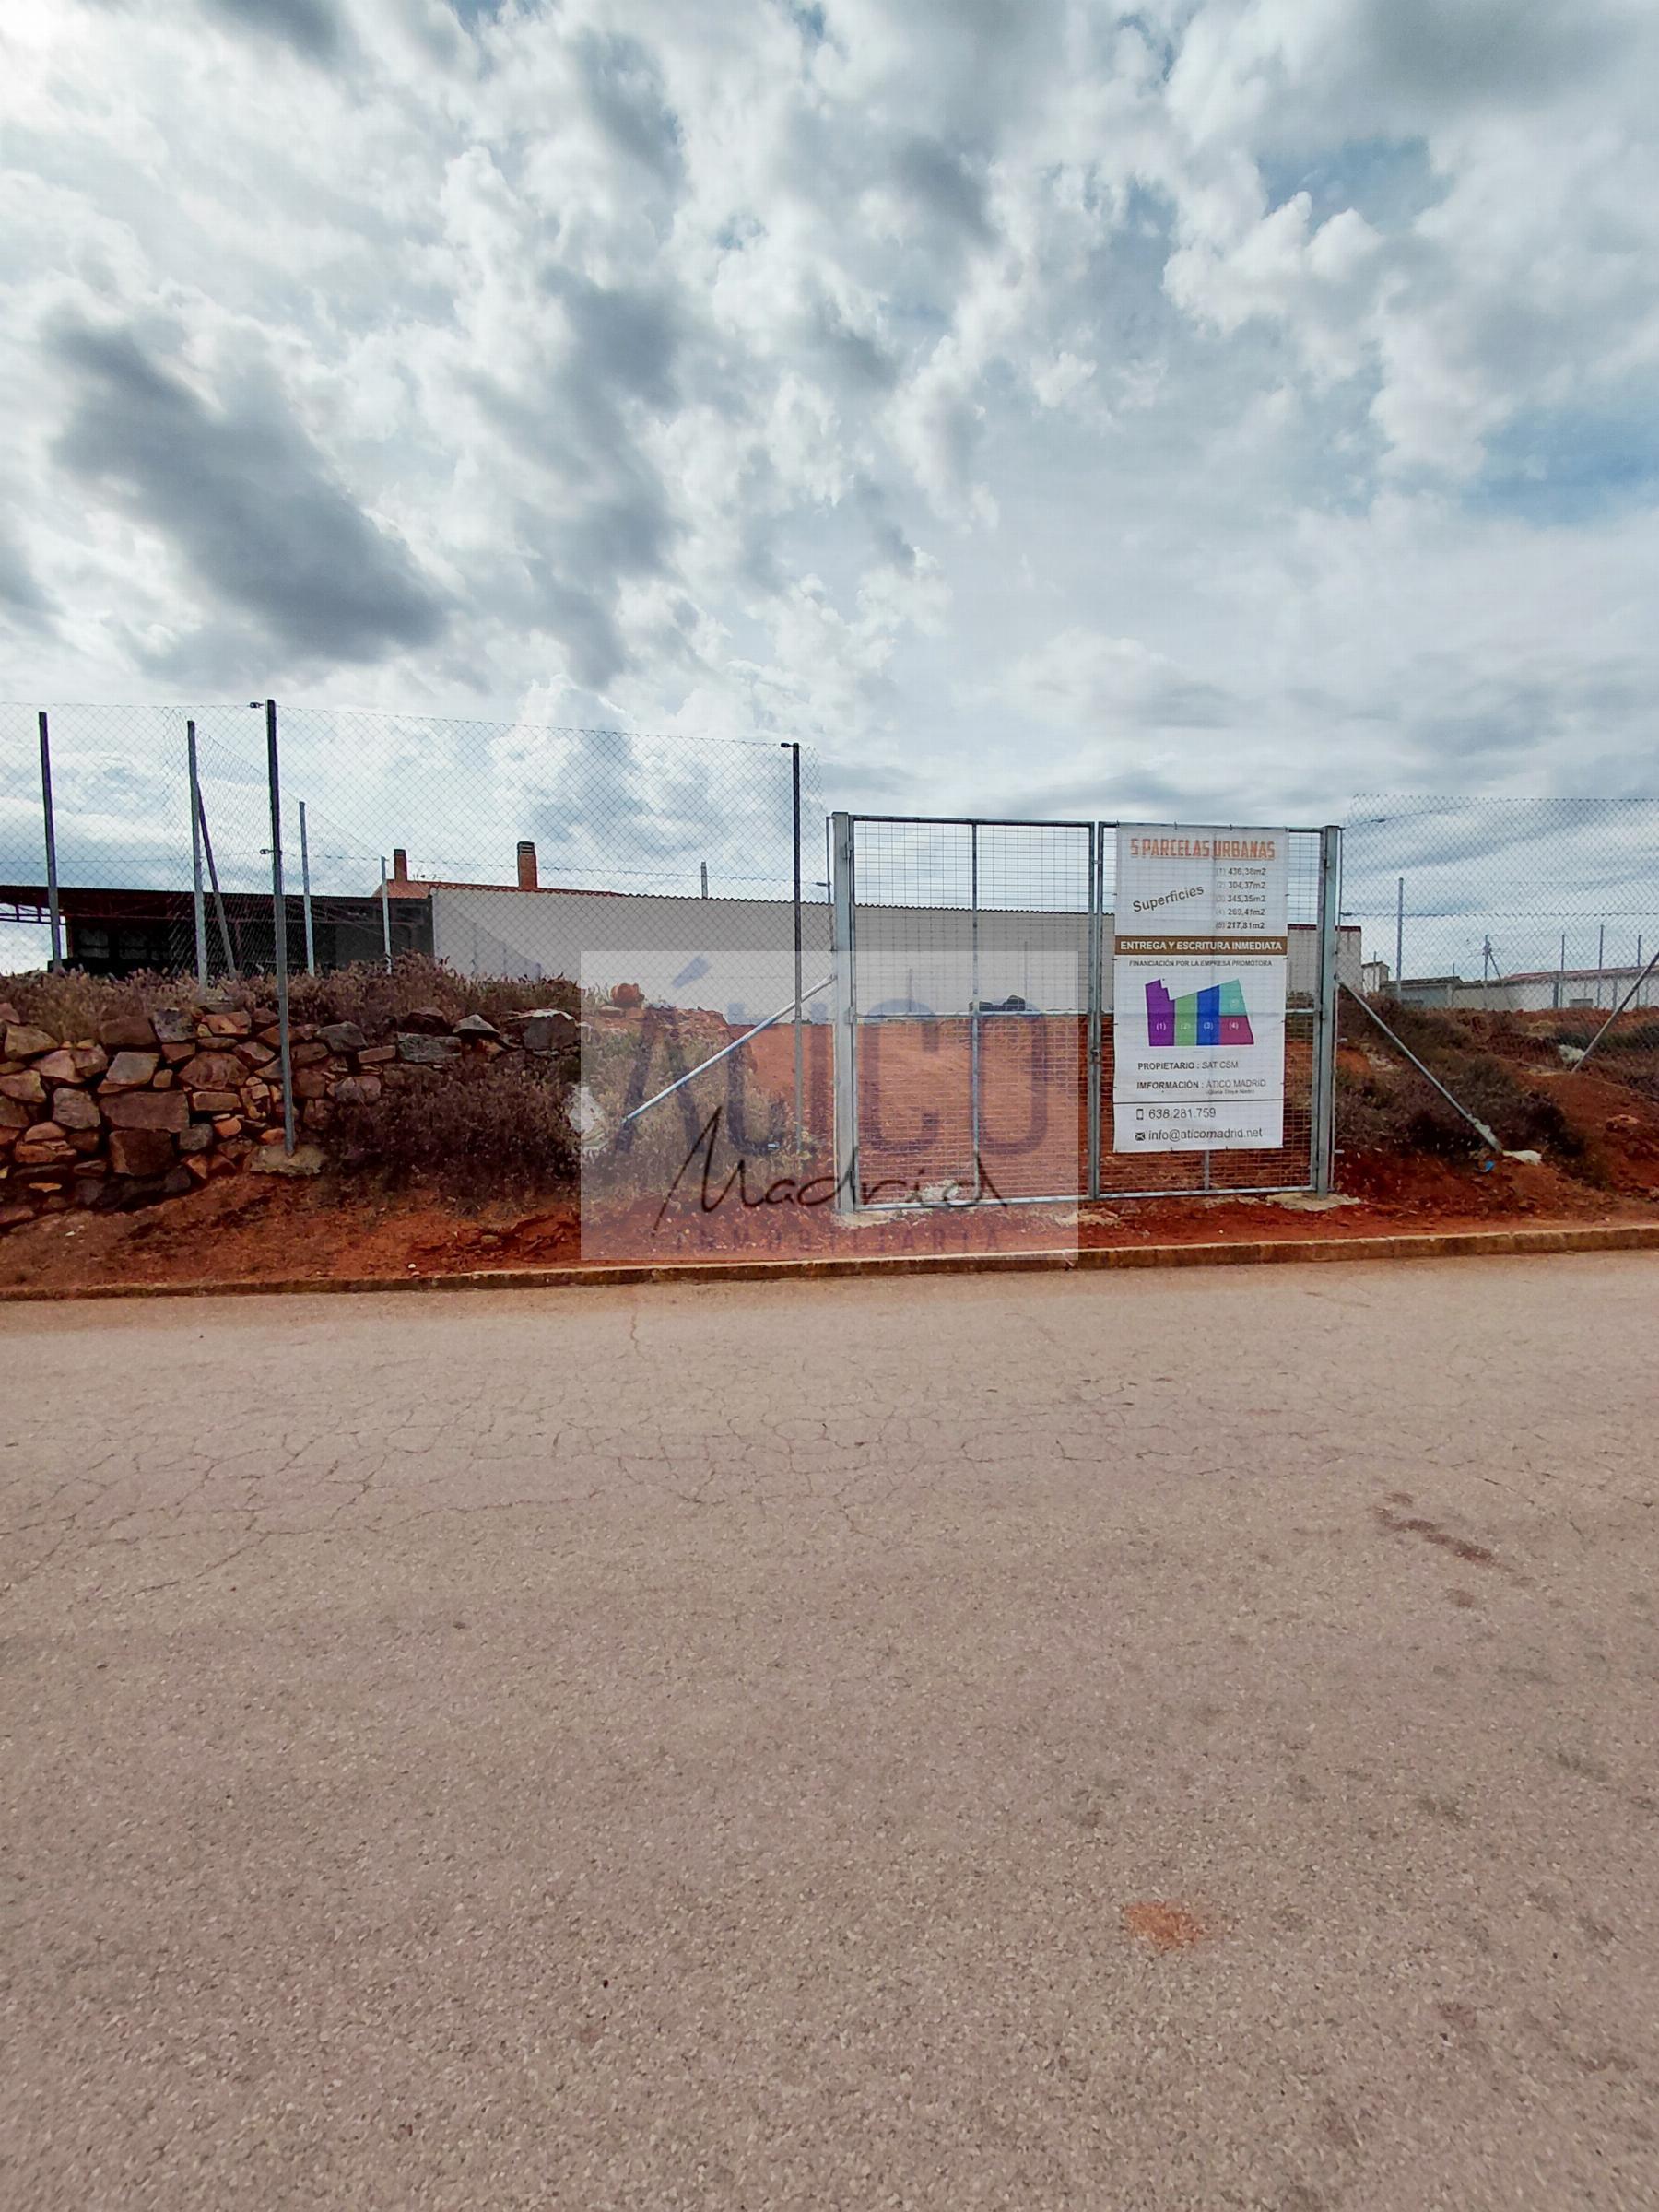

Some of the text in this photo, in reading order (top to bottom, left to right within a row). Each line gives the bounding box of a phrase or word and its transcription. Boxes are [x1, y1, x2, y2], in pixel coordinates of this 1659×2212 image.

[1131, 838, 1276, 859] 5 PARCELAS URBANAS
[1133, 886, 1205, 912] Superficies
[1120, 941, 1282, 950] ENTREGA Y ESCRITURA INMEDIATA
[1129, 959, 1174, 967] FINANCIACIÓN
[1156, 1022, 1167, 1030] (1)
[1203, 1021, 1214, 1030] (3)
[1229, 1021, 1239, 1030] (4)
[1137, 1062, 1194, 1070] PROPIETARIO
[1219, 1061, 1239, 1069] CSM
[1233, 1079, 1266, 1088] MADRID
[1148, 1108, 1216, 1119] 638.281.759
[1148, 1127, 1263, 1142] info@aticomadrid.net
